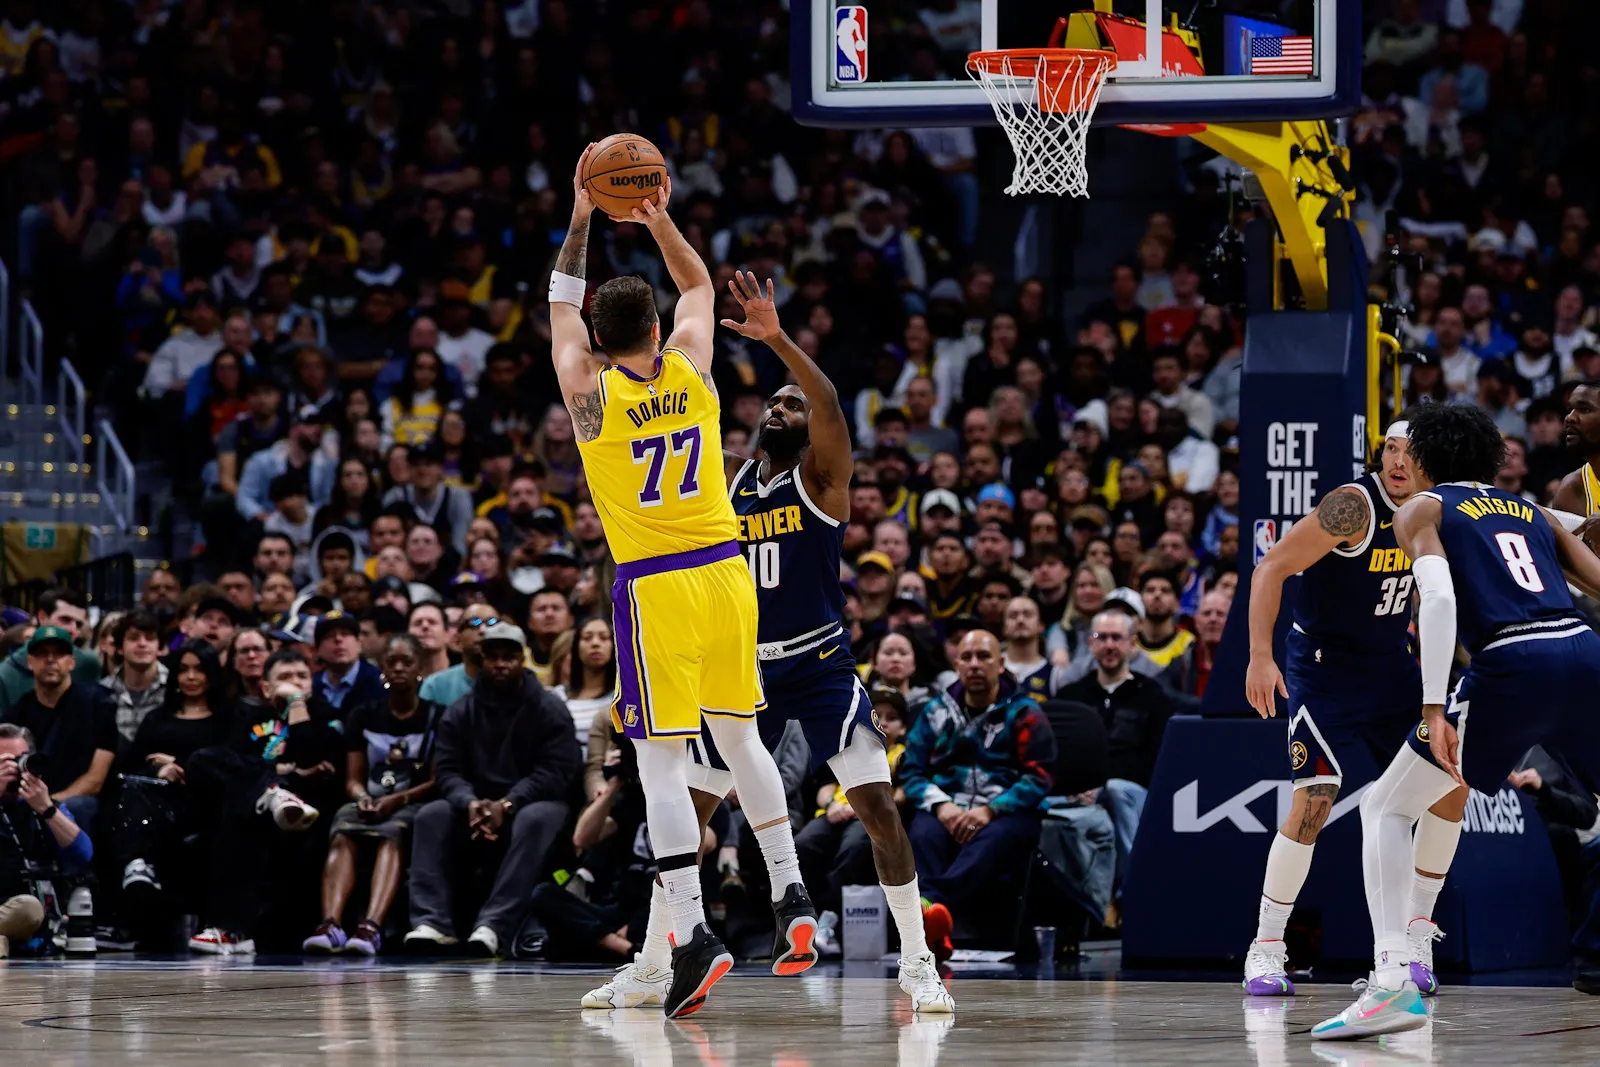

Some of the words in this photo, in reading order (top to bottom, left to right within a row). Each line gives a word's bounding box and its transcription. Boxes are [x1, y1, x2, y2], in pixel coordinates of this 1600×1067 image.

[839, 65, 855, 78] NBA
[610, 171, 662, 190] Wilson
[626, 387, 688, 429] DONČIĆ
[1267, 422, 1319, 467] GET
[630, 424, 702, 508] 77
[1266, 471, 1319, 515] THE
[1456, 497, 1534, 523] WATSON
[736, 505, 804, 541] ENVER
[748, 541, 780, 589] 10
[1368, 548, 1412, 572] DEN
[1494, 532, 1545, 593] 8
[1374, 575, 1414, 616] 32
